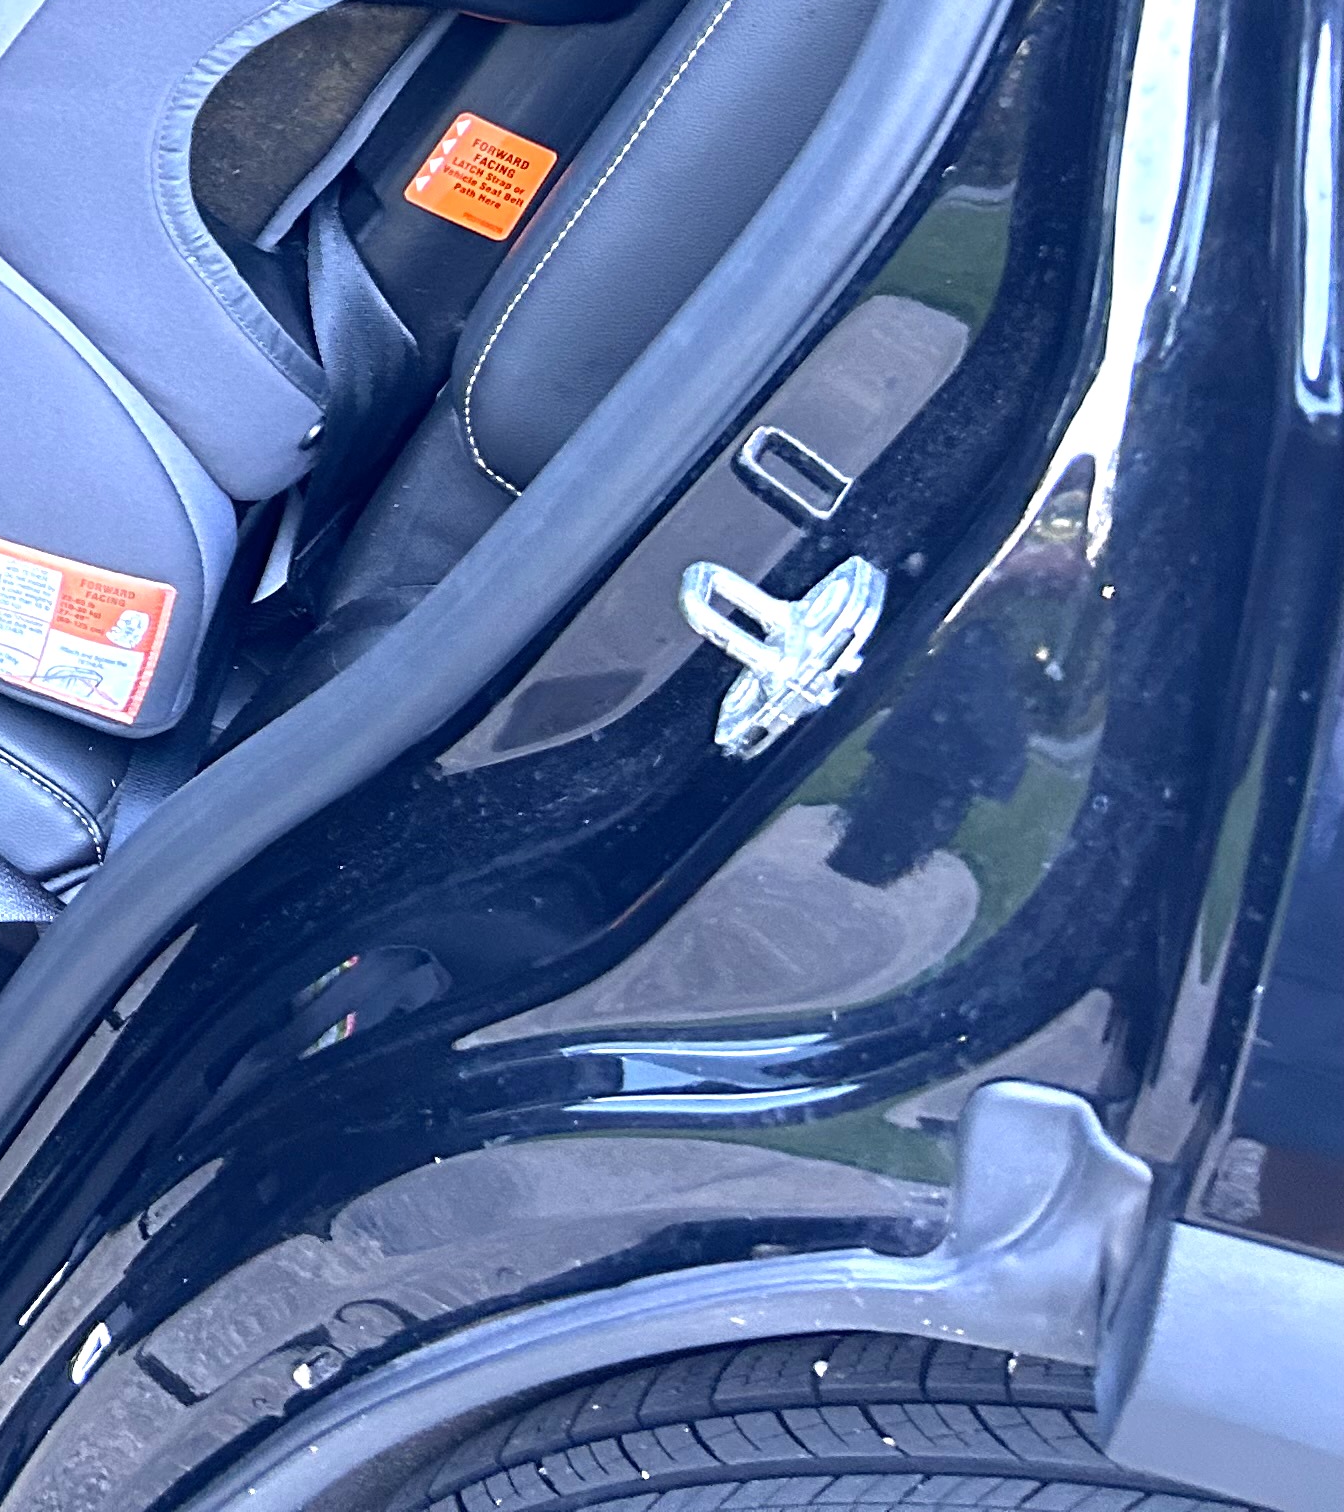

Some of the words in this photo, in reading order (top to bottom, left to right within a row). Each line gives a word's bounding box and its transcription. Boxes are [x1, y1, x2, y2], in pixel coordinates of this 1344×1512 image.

[472, 138, 530, 170] FORWARD
[473, 153, 516, 179] FACING
[443, 165, 478, 187] Vehicle
[479, 182, 502, 197] Seat
[503, 191, 524, 208] Belt
[452, 156, 485, 178] LATCH
[485, 172, 512, 190] Strap
[513, 186, 526, 195] or
[454, 183, 476, 198] Path
[478, 193, 501, 210] Here
[80, 578, 136, 600] FORWARD
[85, 590, 126, 607] FACING
